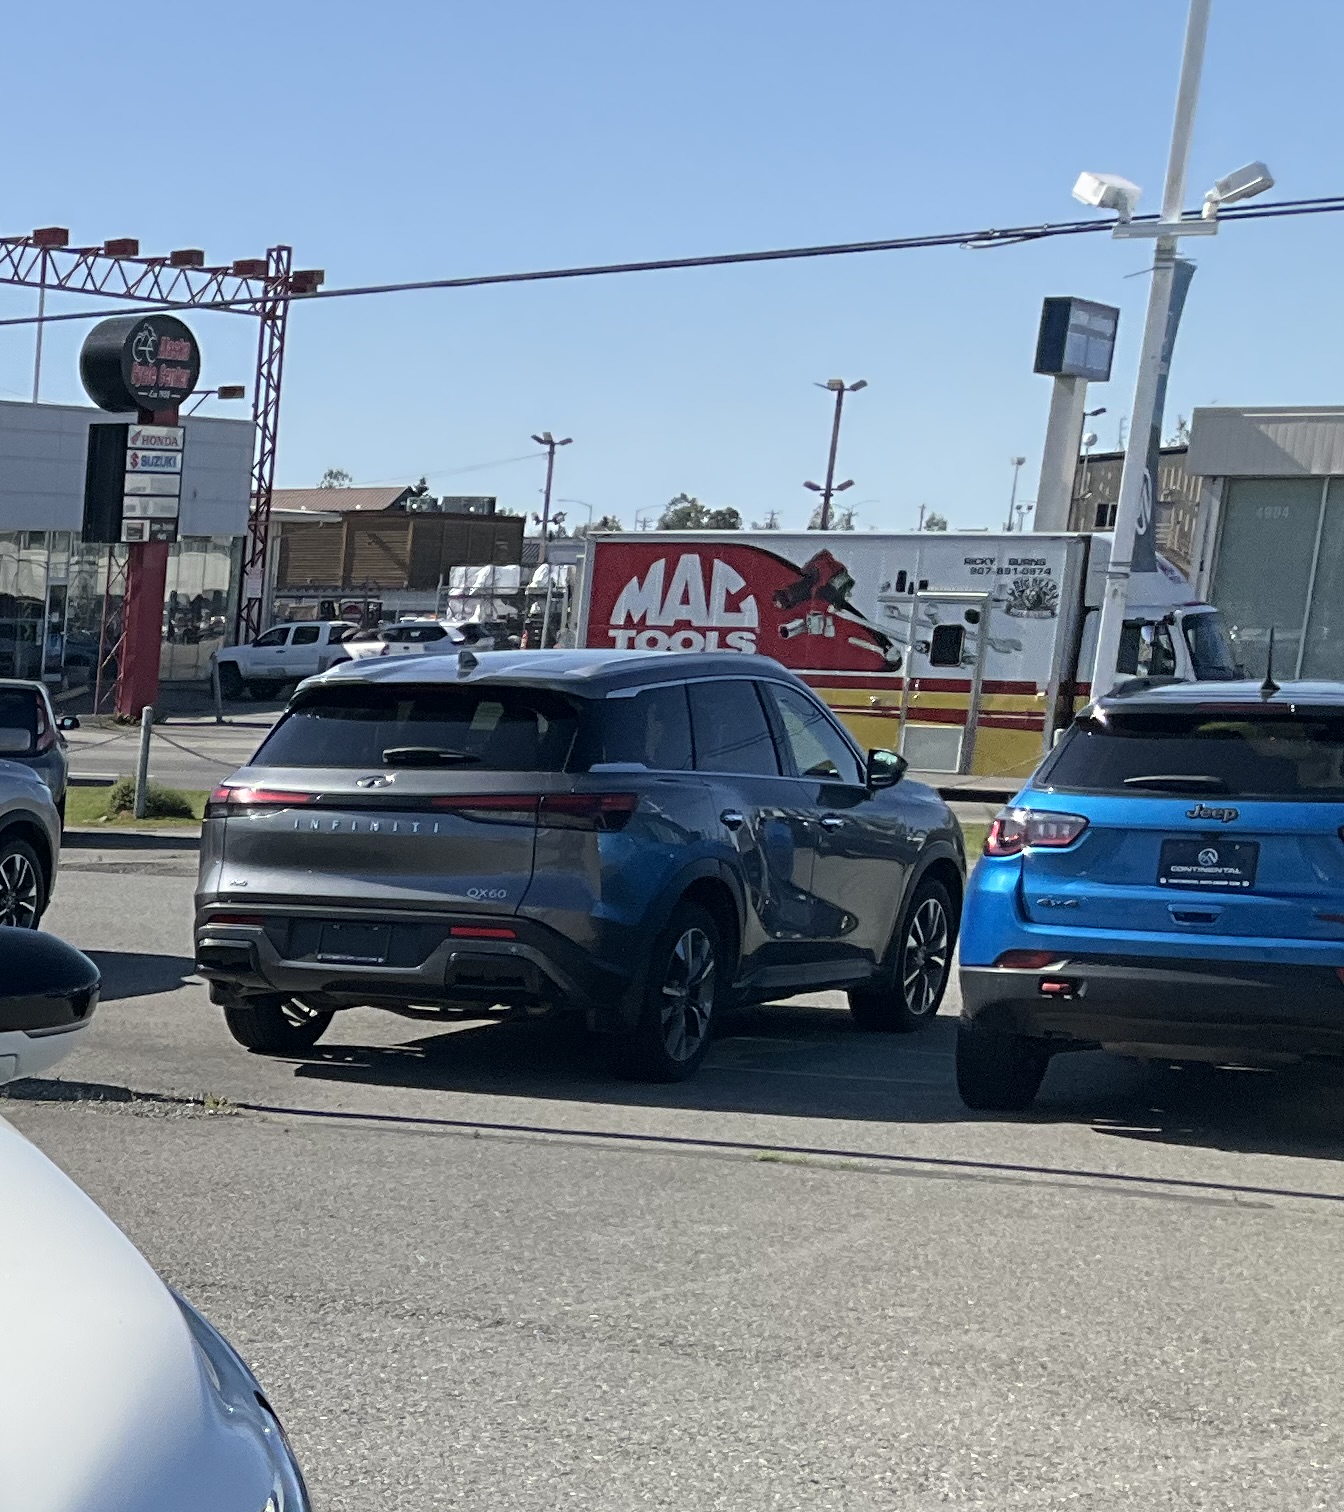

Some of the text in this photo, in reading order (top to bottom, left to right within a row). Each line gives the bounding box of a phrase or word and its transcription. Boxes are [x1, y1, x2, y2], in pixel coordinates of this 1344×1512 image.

[141, 435, 179, 446] HONDA
[140, 455, 177, 467] SUZUKI
[610, 553, 759, 628] MAC
[608, 629, 758, 654] TOOLS
[1186, 803, 1240, 823] Jeep
[294, 818, 439, 834] INFINITI
[1170, 865, 1243, 875] CONTINENTAL
[467, 887, 507, 899] QX60
